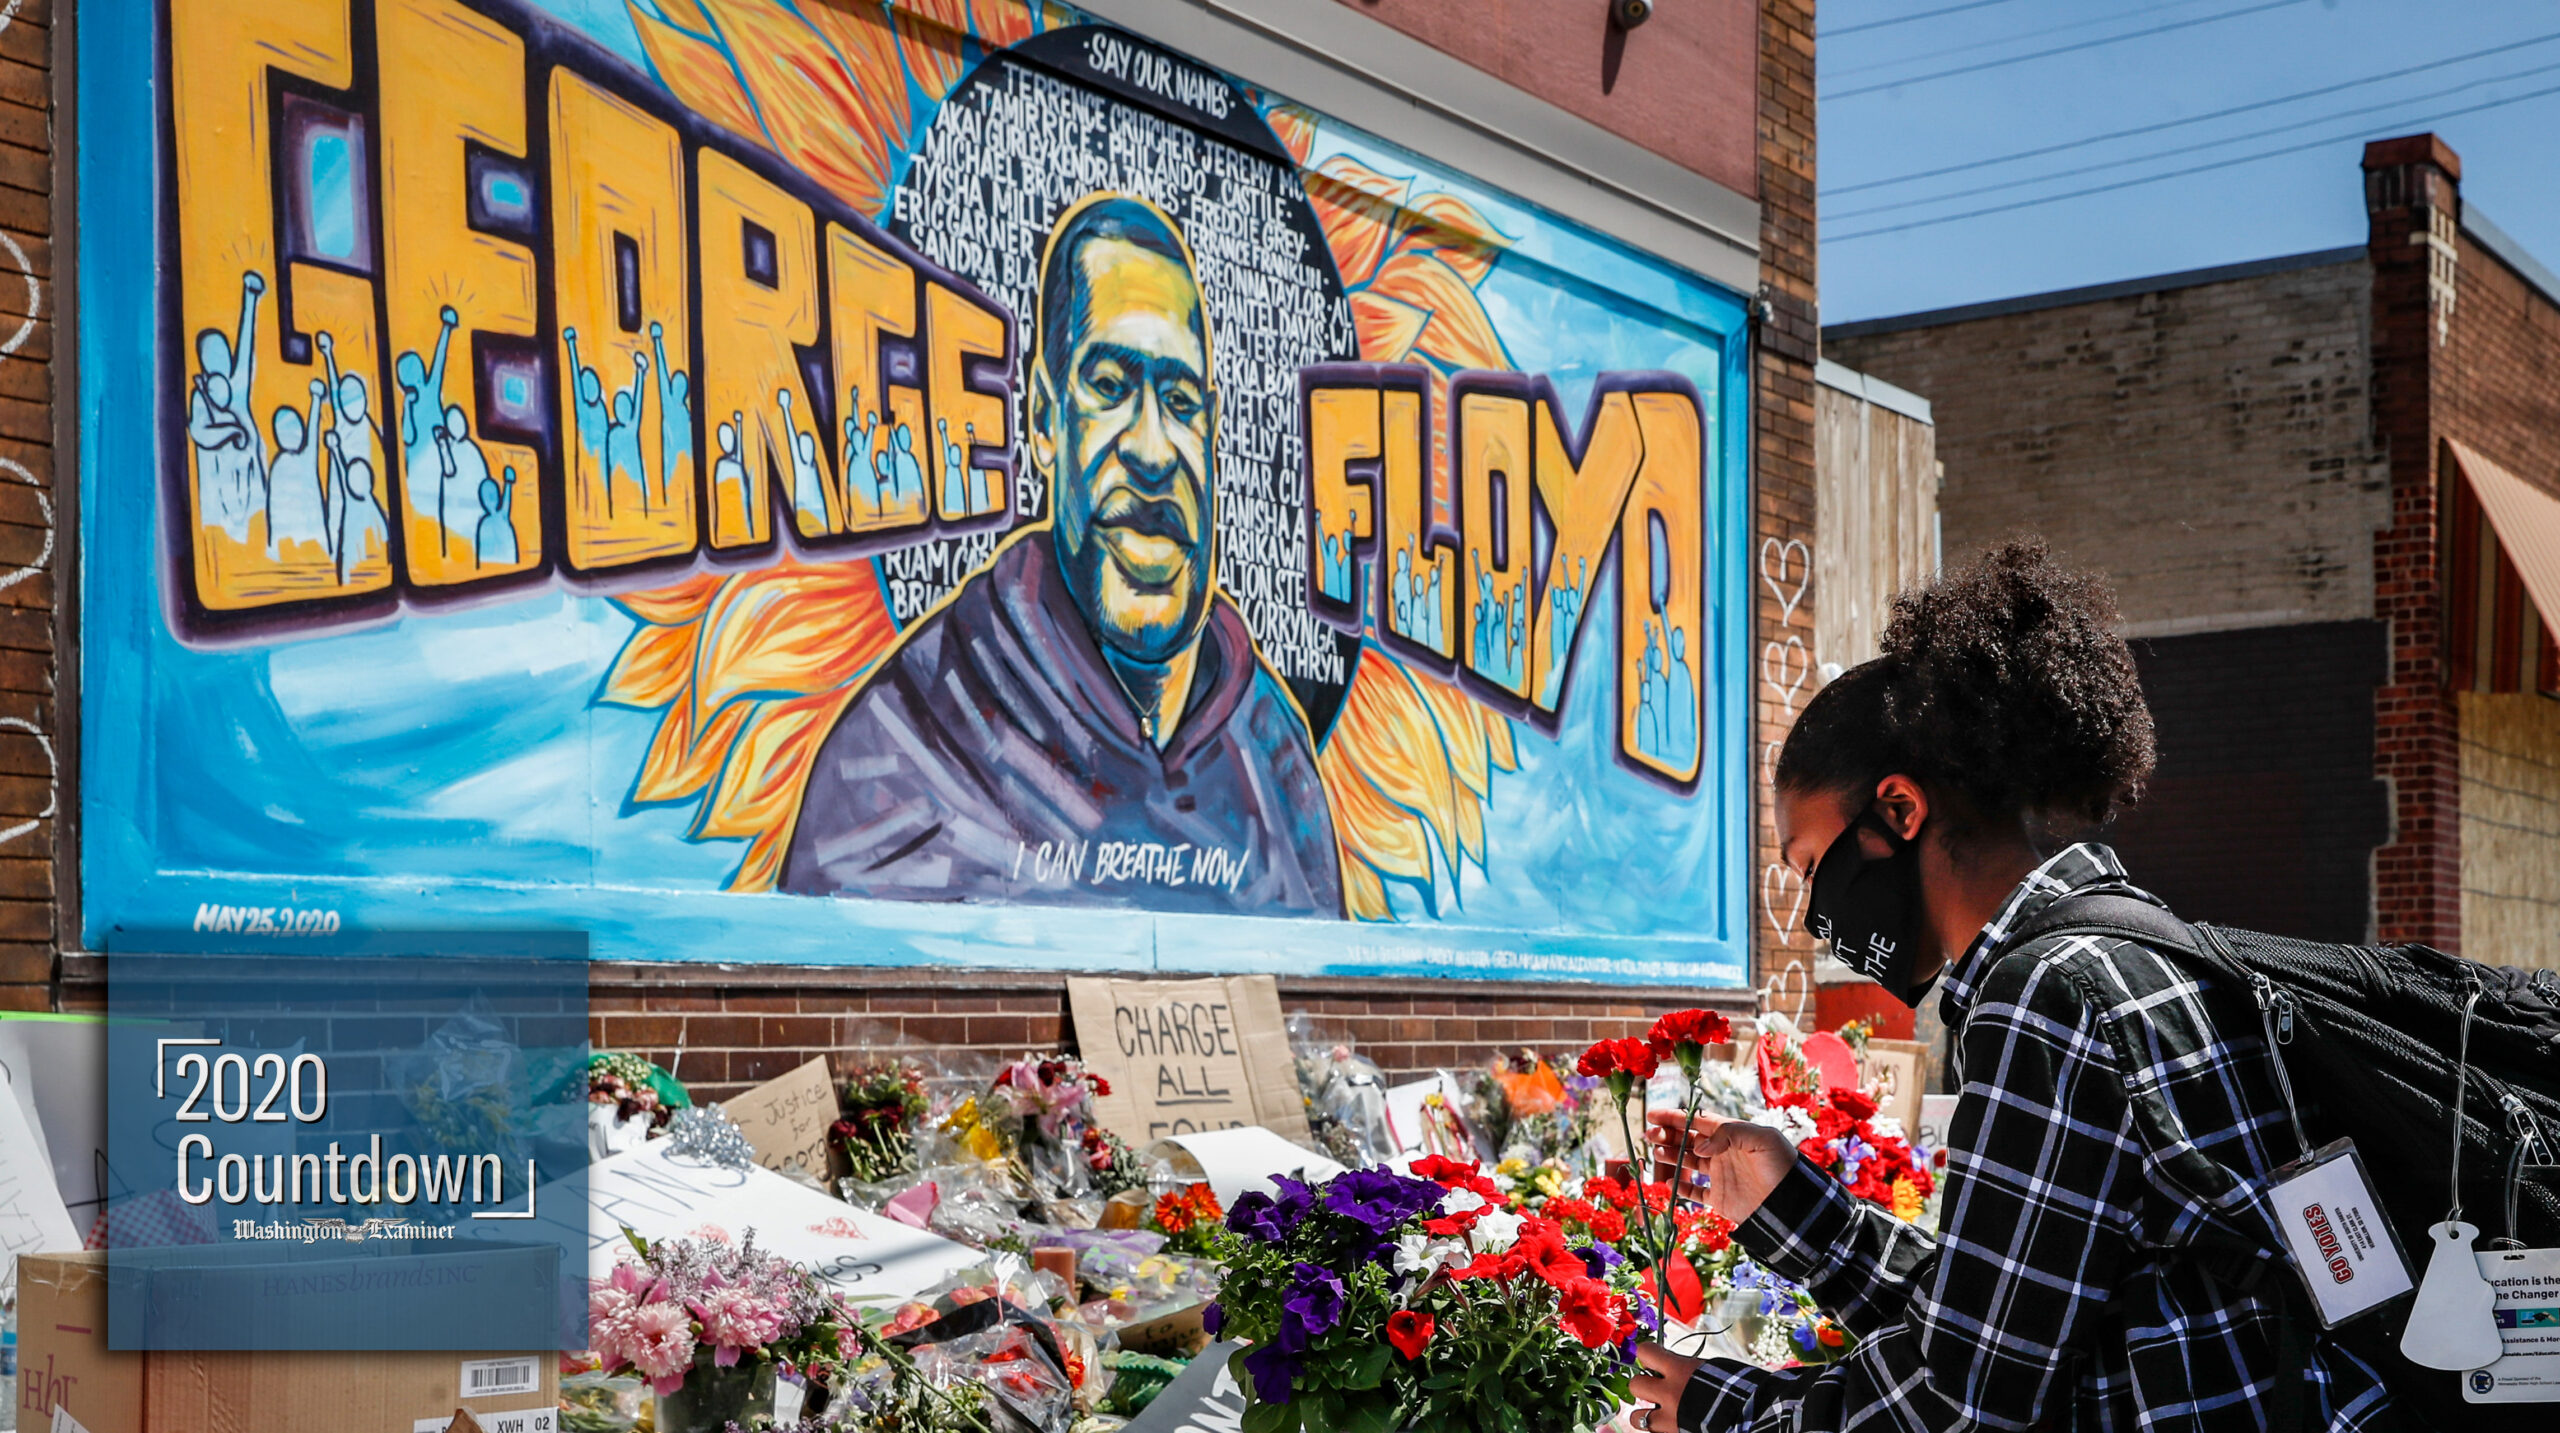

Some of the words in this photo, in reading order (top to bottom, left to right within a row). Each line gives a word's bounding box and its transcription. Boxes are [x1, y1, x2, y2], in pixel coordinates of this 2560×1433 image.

[1089, 32, 1132, 81] SAY
[1133, 50, 1174, 99] OUR
[1176, 65, 1229, 120] NAMES
[1002, 60, 1107, 133] TERRENCE
[1110, 103, 1196, 167] CRUTCHER
[1201, 138, 1273, 192] JEREMY
[926, 126, 1017, 187] MICHAEL
[935, 100, 982, 145] AKAI
[985, 118, 1048, 167] GURLEY
[1050, 141, 1120, 195] KENDRA
[1121, 165, 1179, 215] JAMES
[1190, 194, 1260, 244] FREDDIE
[1262, 222, 1305, 261] GREY
[974, 81, 1040, 140] TAMIR
[1042, 104, 1092, 154] RICE
[1109, 132, 1206, 196] PHILANDO
[1221, 178, 1287, 228] CASTILE
[910, 153, 985, 212] TYISHA
[895, 184, 944, 231] ERIC
[946, 203, 1036, 262] GARNER
[910, 223, 998, 283] SANDRA
[1179, 217, 1250, 266] TERRANCE
[1252, 245, 1322, 290] FRANKLIN
[160, 0, 1010, 622] GEORGE
[1204, 283, 1278, 336] SHANTEL
[1279, 308, 1325, 350] DAVIS
[1209, 316, 1277, 367] WALTER
[1213, 351, 1261, 393] REKIA
[1218, 414, 1278, 462] SHELLY
[1216, 451, 1275, 502] JAMAR
[1217, 490, 1290, 540] TANISHA
[1216, 556, 1272, 600] ALTON
[1304, 380, 1706, 790] FLOYD
[1263, 640, 1345, 685] KATHRYN
[1013, 841, 1025, 881] I
[1035, 840, 1089, 882] CAN
[1091, 839, 1191, 887] BREATHE
[1191, 845, 1250, 894] NOW
[1864, 932, 1896, 978] THE
[1115, 1001, 1237, 1057] CHARGE
[763, 1084, 827, 1126] Justice
[1157, 1064, 1230, 1098] ALL
[790, 1117, 811, 1142] for
[2303, 1203, 2342, 1262] YOTES
[2328, 1256, 2354, 1284] GO
[2511, 1289, 2560, 1300] Changer
[2531, 1275, 2542, 1286] is
[2543, 1275, 2560, 1285] the
[535, 1416, 550, 1431] 02
